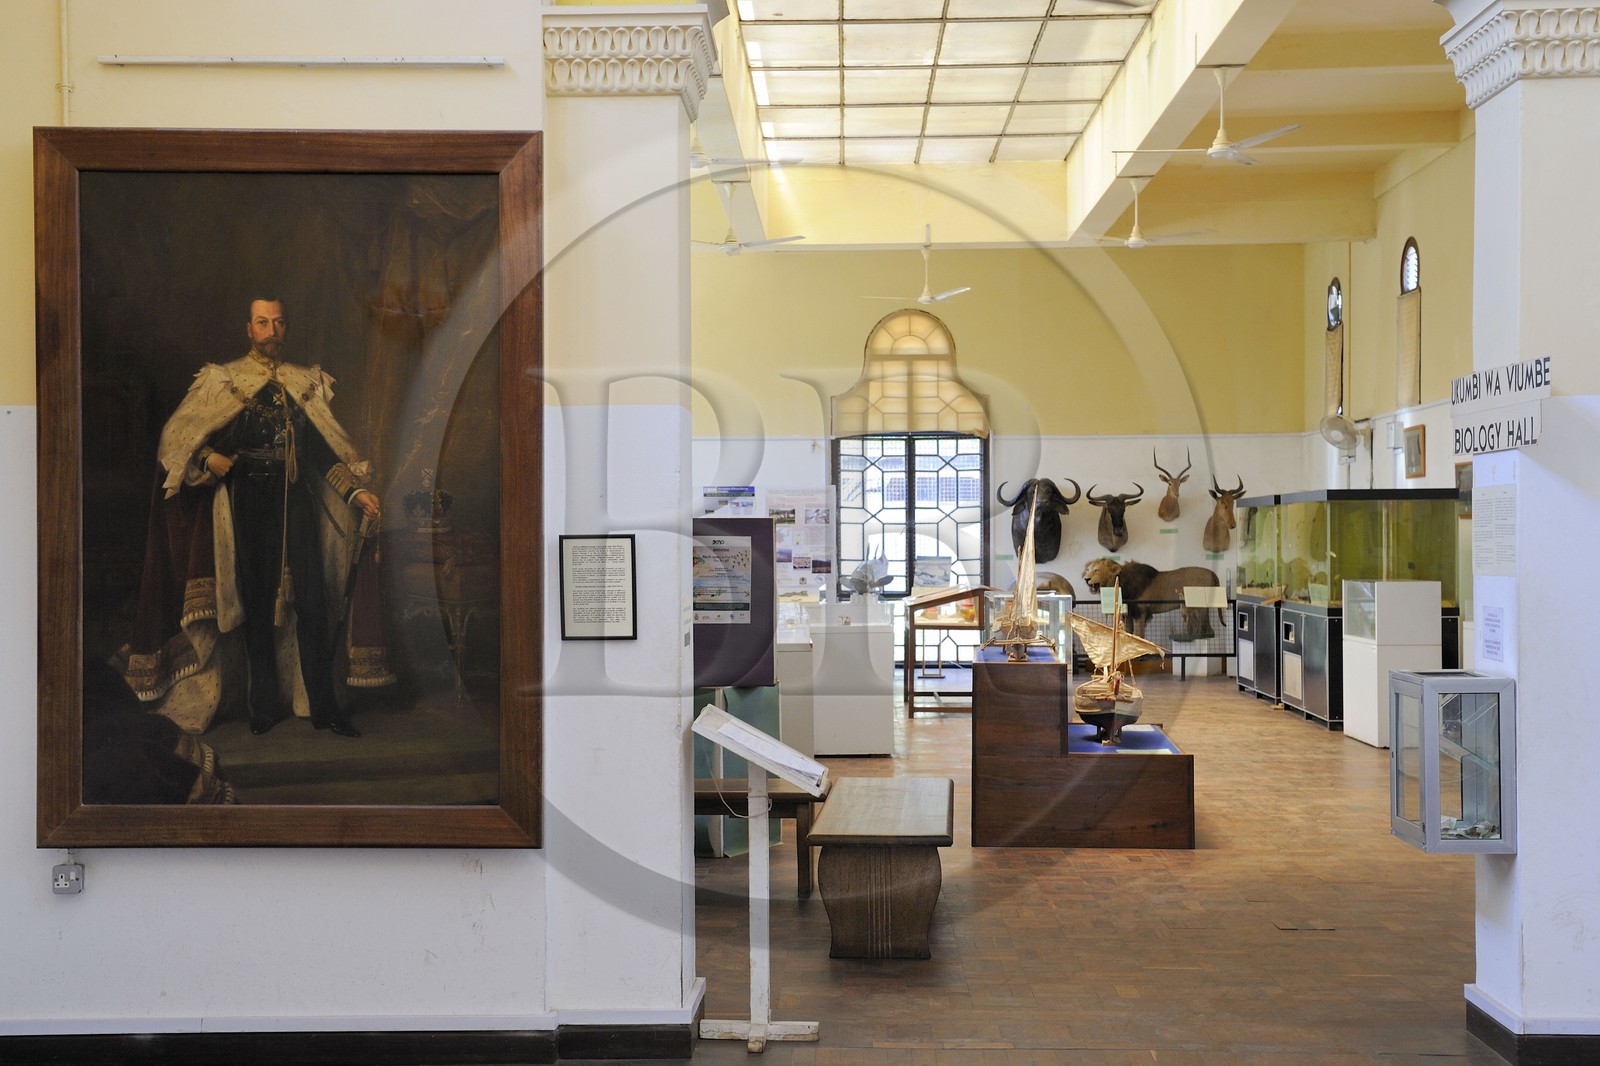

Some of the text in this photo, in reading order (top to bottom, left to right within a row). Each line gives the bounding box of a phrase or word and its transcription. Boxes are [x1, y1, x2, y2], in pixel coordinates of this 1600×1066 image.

[1451, 356, 1551, 406] UKUMBI WA VIUMBE
[1454, 416, 1538, 455] BIOLOGY HALL
